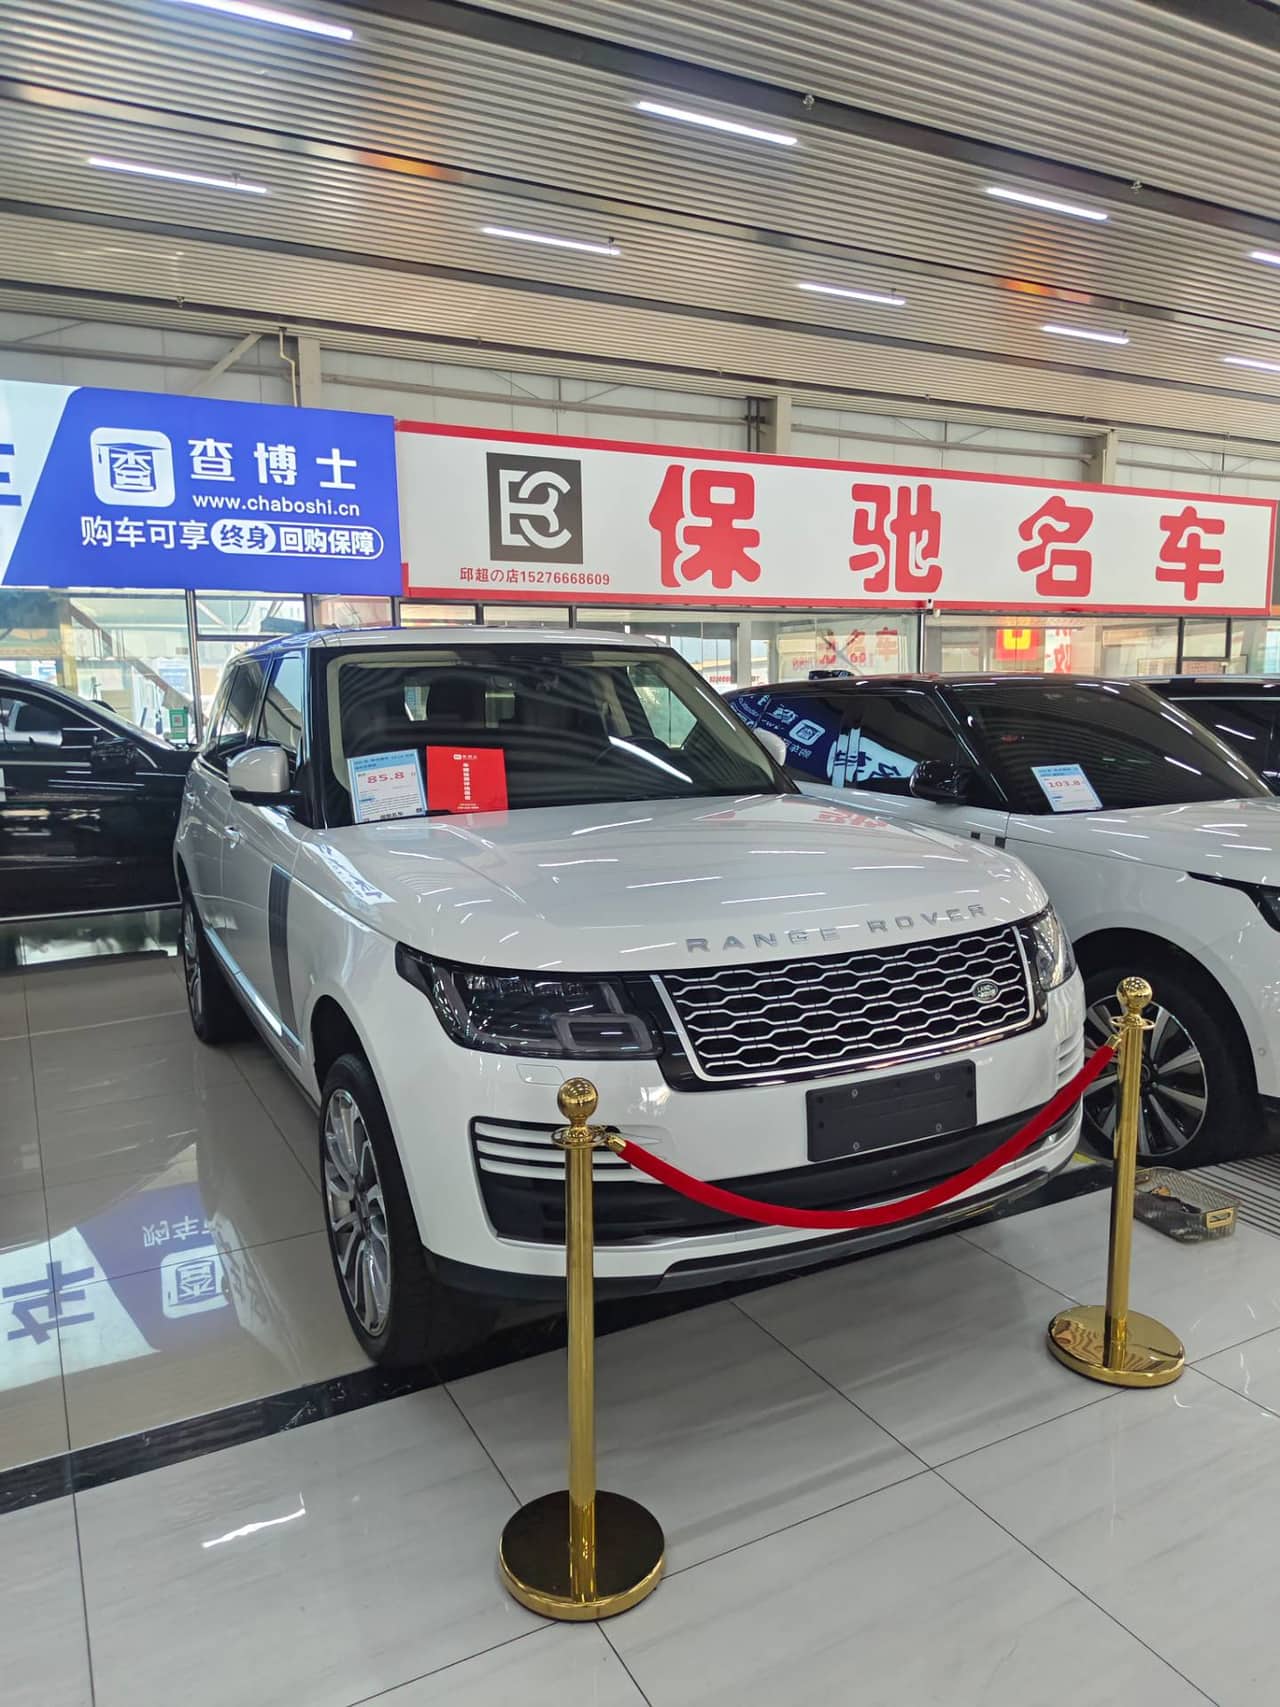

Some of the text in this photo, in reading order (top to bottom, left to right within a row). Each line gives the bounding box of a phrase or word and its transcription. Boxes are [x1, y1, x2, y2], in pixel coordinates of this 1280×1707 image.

[188, 438, 358, 490] 查博士
[192, 493, 360, 517] www.chaboshi.cn
[649, 464, 1226, 601] 保驰名车
[367, 771, 405, 784] 85.8
[686, 903, 987, 953] RANGE ROVER
